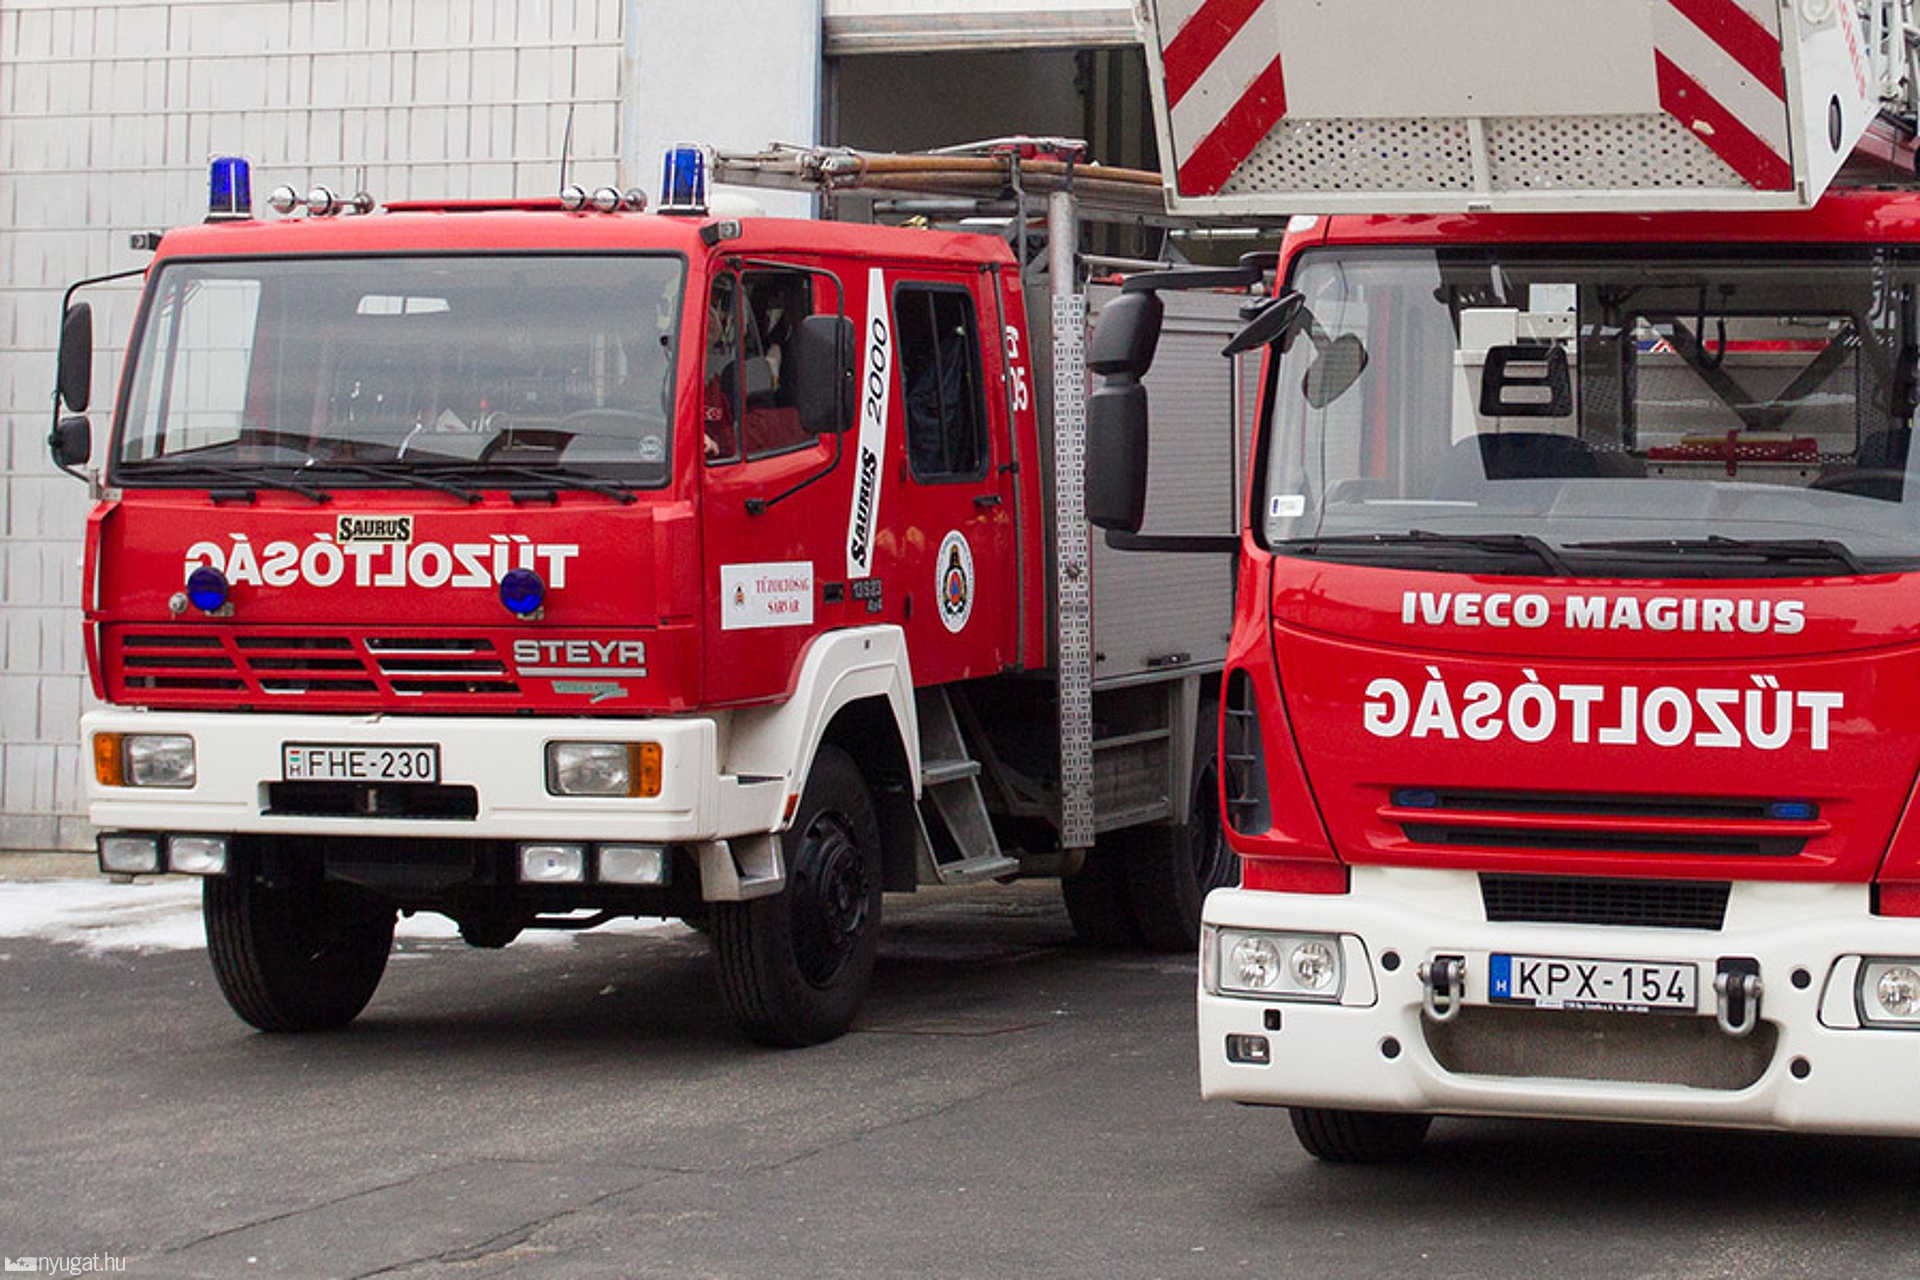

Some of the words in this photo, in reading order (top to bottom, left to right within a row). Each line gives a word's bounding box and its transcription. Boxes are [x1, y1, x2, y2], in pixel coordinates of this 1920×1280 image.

[867, 317, 888, 427] 2000
[1402, 591, 1549, 628] IVECO
[1564, 596, 1806, 634] MAGIRUS
[513, 639, 646, 664] STEYR
[308, 750, 431, 779] FHE-230
[1496, 979, 1508, 993] H
[1519, 961, 1685, 1003] KPX-154
